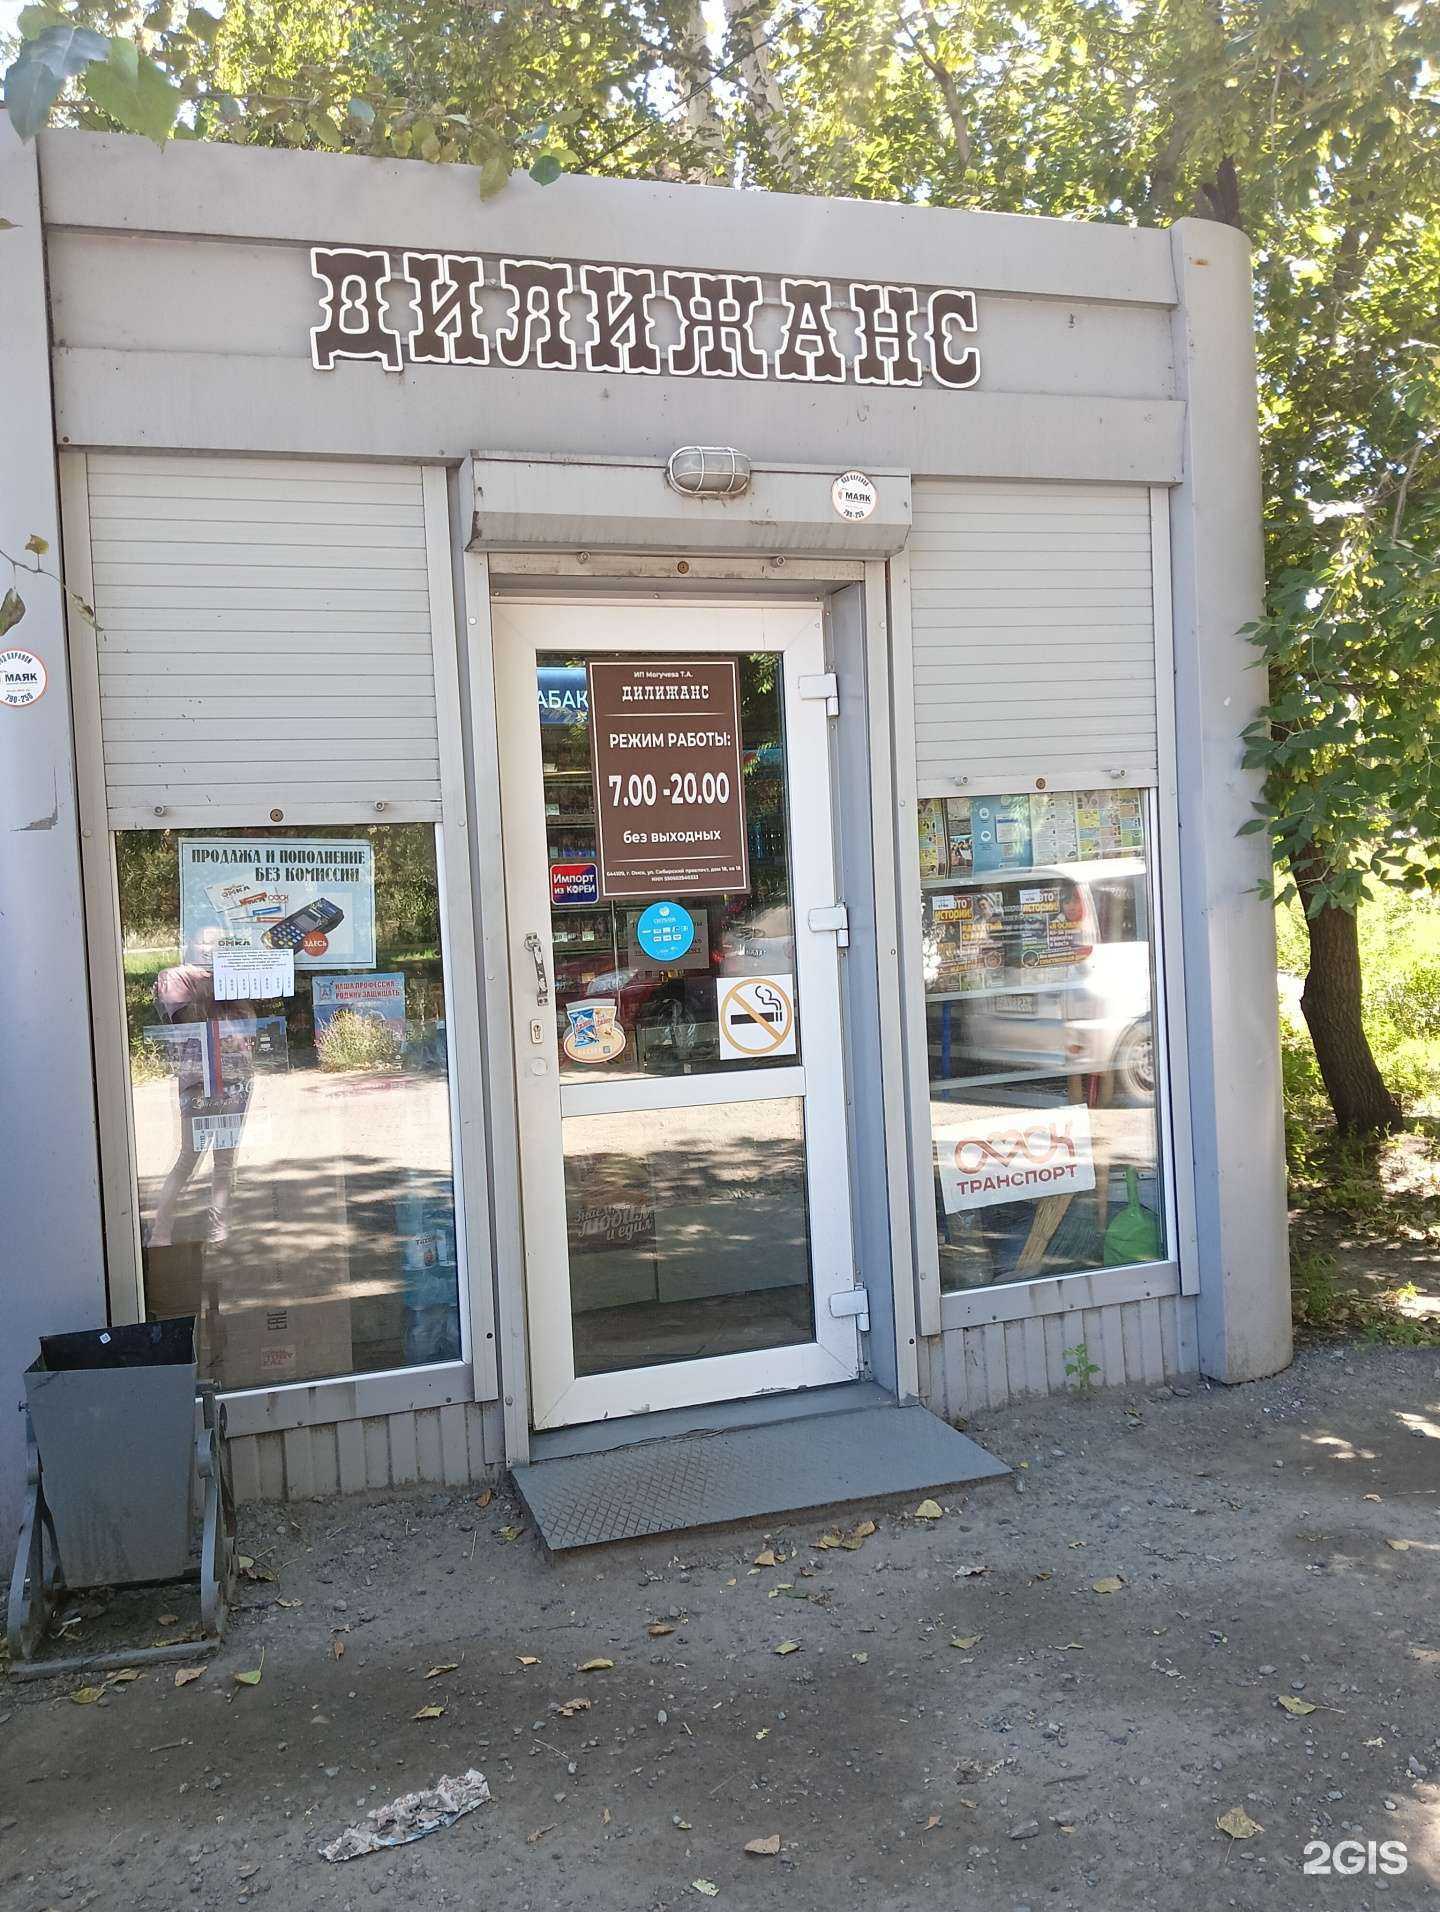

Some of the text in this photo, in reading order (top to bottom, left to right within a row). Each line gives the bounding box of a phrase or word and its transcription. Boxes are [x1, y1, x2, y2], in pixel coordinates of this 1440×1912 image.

[311, 247, 981, 389] ДИЛИЖАНС
[845, 491, 871, 502] МАЯК
[5, 672, 38, 682] МАЯК
[622, 685, 710, 702] ДИЛИЖАНС
[609, 732, 731, 748] РЕЖИМ РАБОТЫ:
[608, 774, 657, 807] 7.00
[623, 830, 721, 844] без выходных
[191, 849, 366, 865] ПРОДАЖА И ПОПОЛНЕНИЕ
[255, 867, 360, 882] БЕЗ КОМИССИИ
[553, 873, 594, 885] Импорт
[554, 887, 565, 895] из
[218, 939, 251, 948] ОМКА
[303, 940, 327, 948] ЗДЕСЬ
[355, 981, 395, 989] ПРОФЕССИЯ
[957, 1164, 1077, 1195] ТРАНСПОРТ
